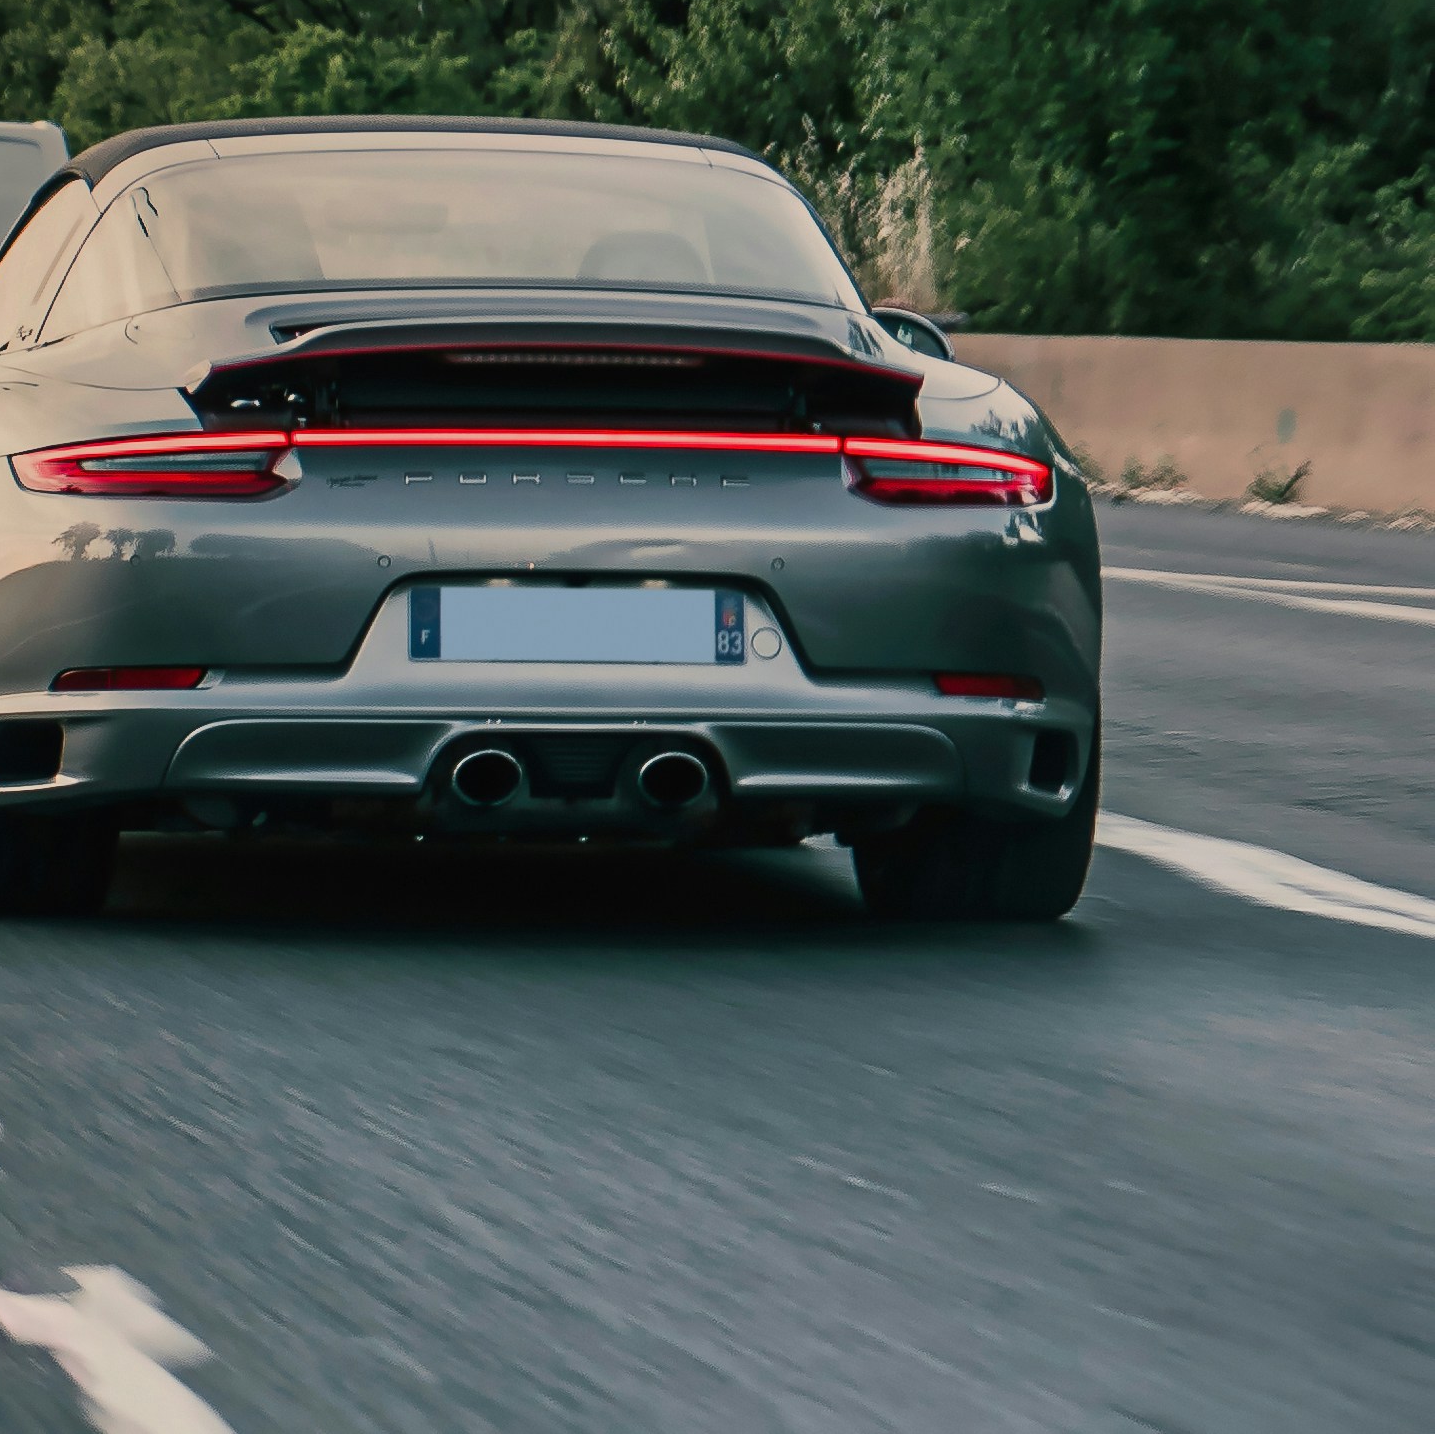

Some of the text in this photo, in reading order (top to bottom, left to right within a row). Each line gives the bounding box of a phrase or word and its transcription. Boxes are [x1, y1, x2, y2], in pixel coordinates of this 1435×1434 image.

[404, 472, 751, 489] PORSCHE
[420, 629, 431, 645] F
[717, 630, 743, 655] 83
